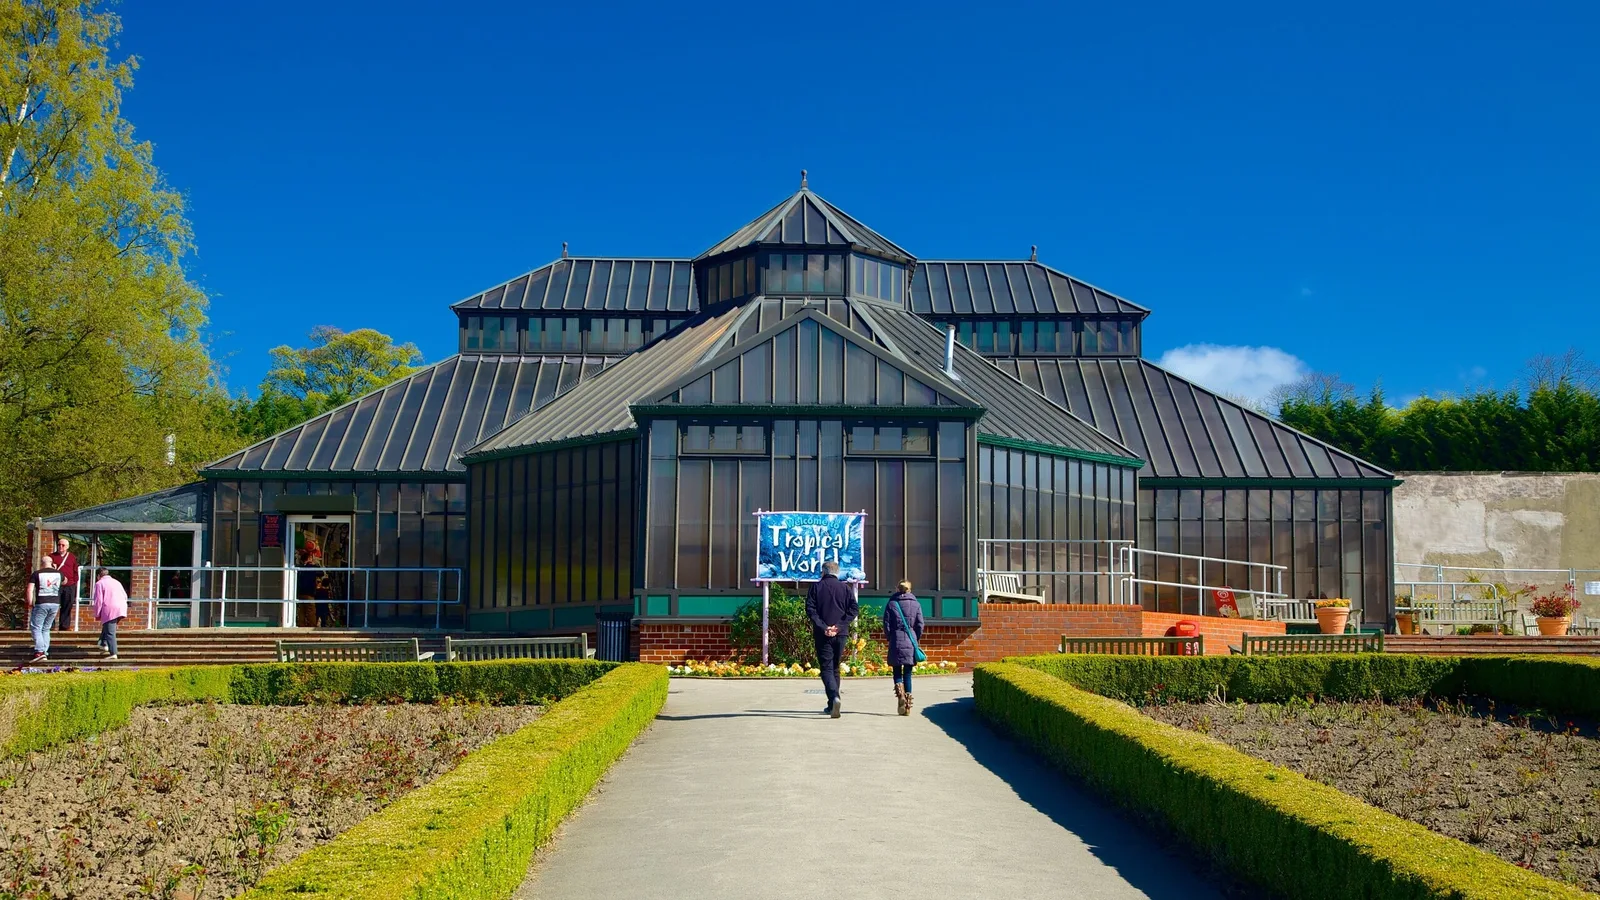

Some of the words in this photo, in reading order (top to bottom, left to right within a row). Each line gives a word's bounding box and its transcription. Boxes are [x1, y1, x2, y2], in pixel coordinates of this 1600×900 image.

[768, 516, 852, 555] Tropical
[785, 517, 828, 528] Welcome
[830, 520, 840, 529] to
